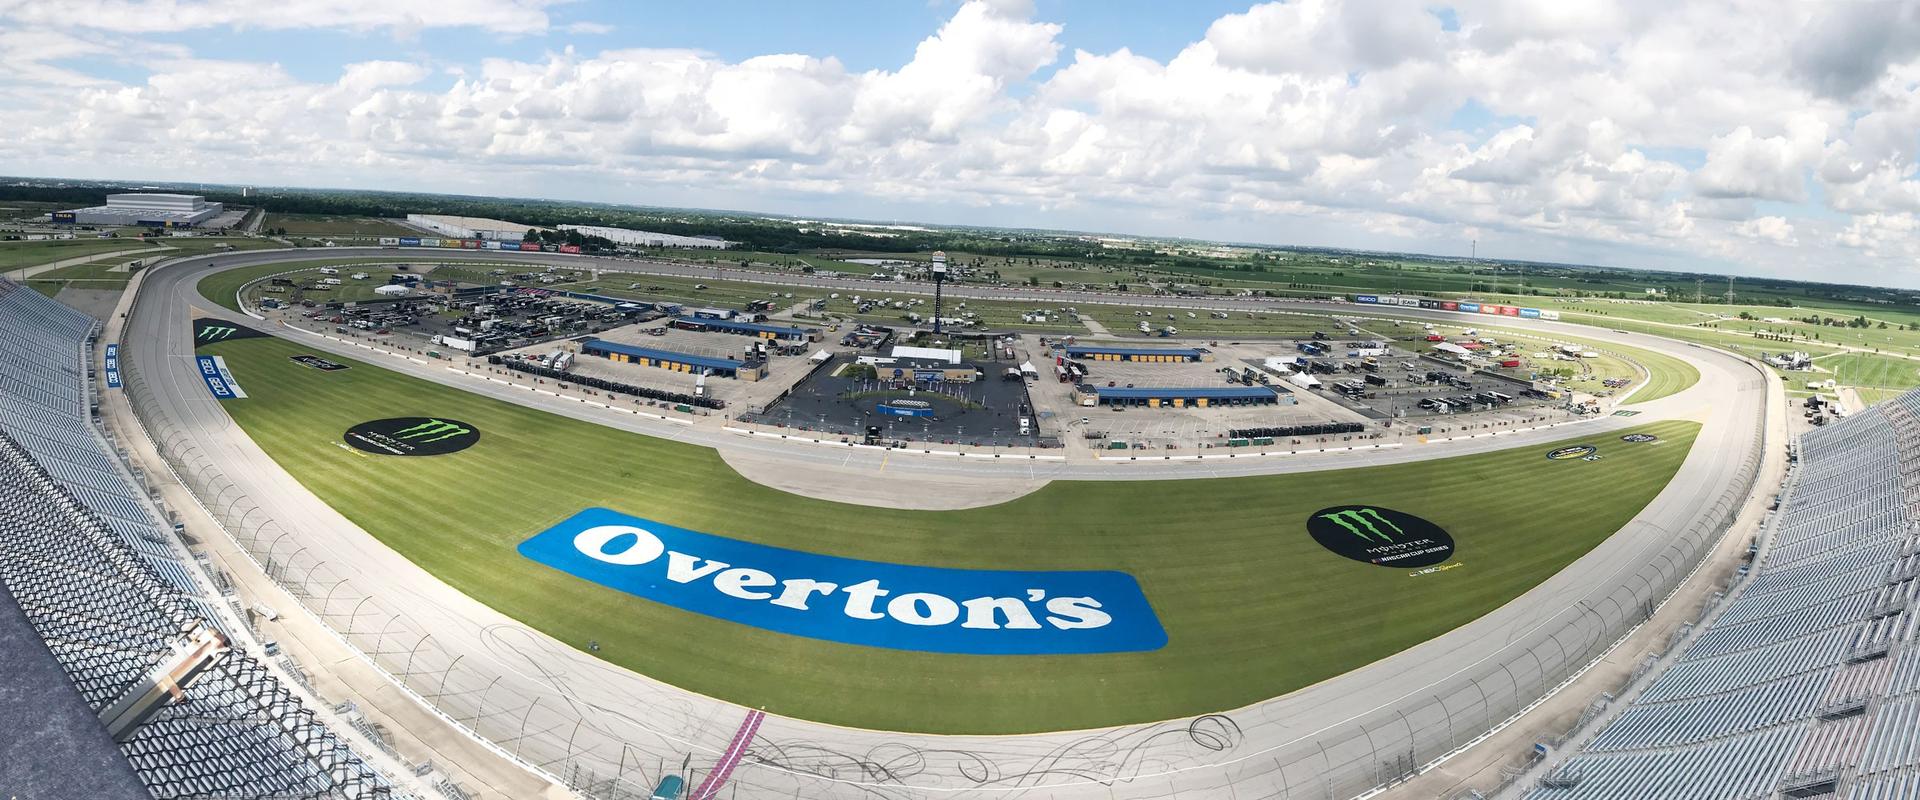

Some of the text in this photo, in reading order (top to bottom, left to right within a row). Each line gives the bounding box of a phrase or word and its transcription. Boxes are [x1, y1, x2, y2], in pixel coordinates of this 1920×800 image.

[200, 358, 216, 375] GEICO
[108, 371, 118, 384] GEICO
[207, 377, 230, 396] GEICO
[1366, 538, 1435, 554] MONSTER
[1381, 552, 1411, 562] NASCAR
[1424, 544, 1449, 554] SERIES
[574, 525, 1112, 631] Overton's
